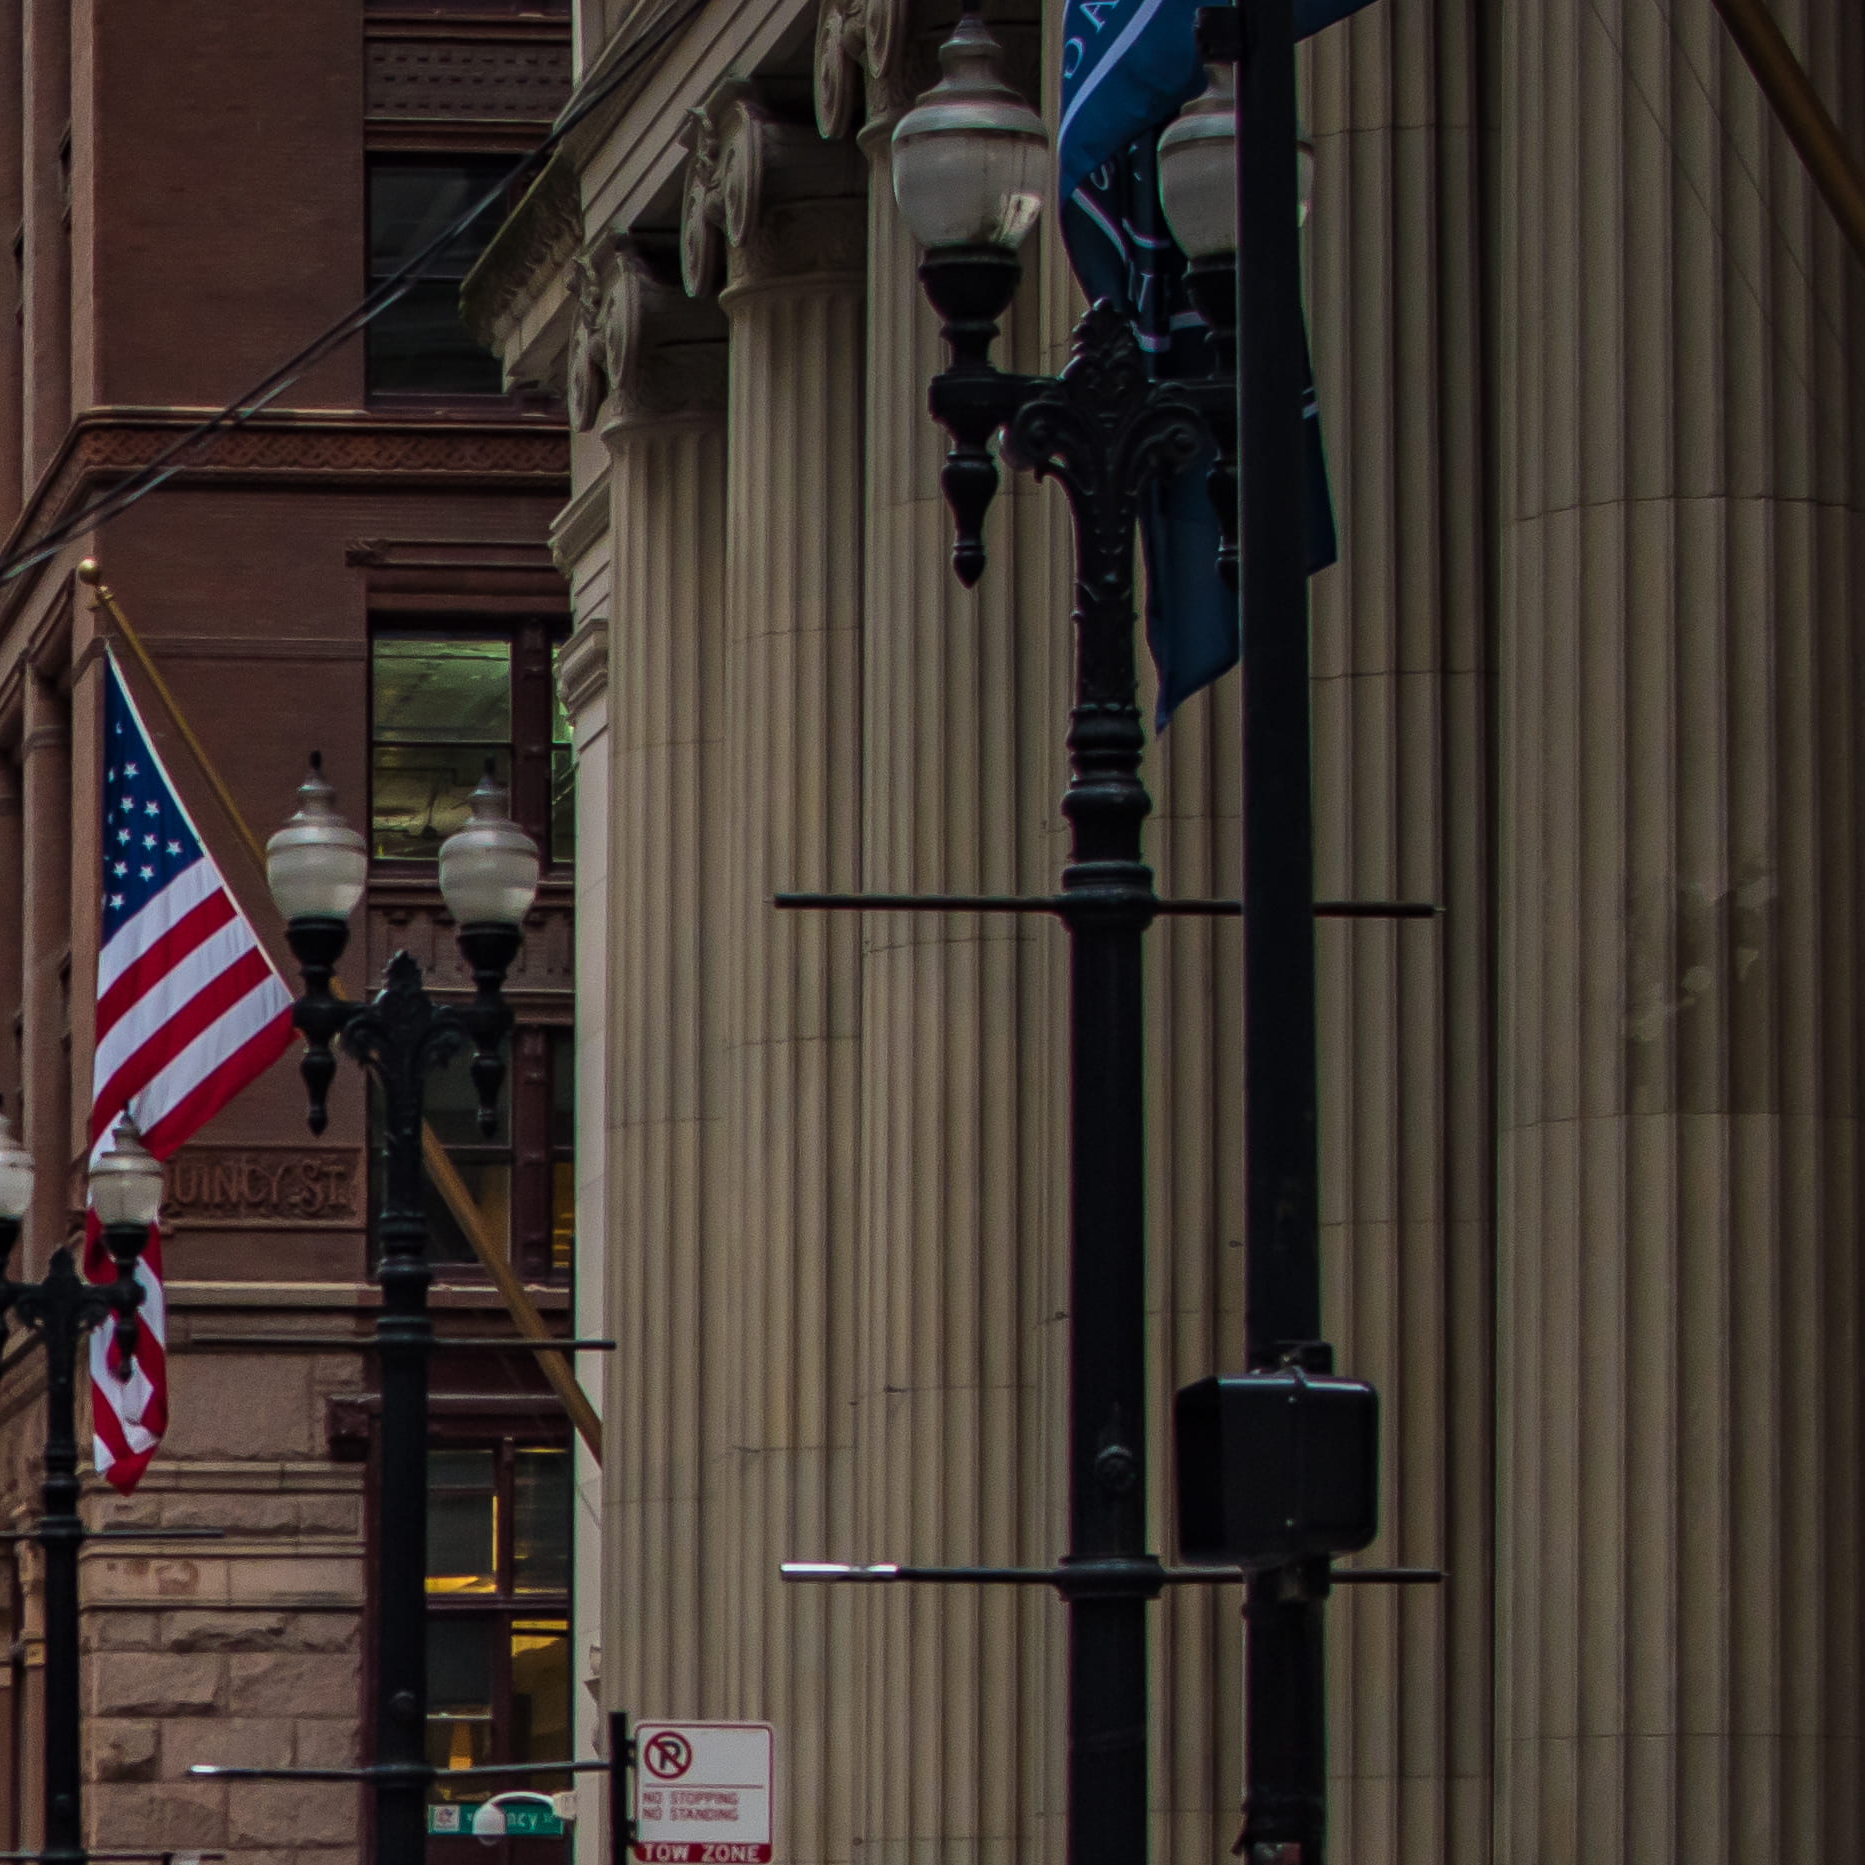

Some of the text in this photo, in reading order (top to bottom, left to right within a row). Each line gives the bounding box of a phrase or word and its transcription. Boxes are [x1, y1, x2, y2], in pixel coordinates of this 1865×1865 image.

[643, 1791, 739, 1806] NO STOPPING
[642, 1807, 739, 1822] NO STANDING
[644, 1844, 760, 1863] TOW ZONE
